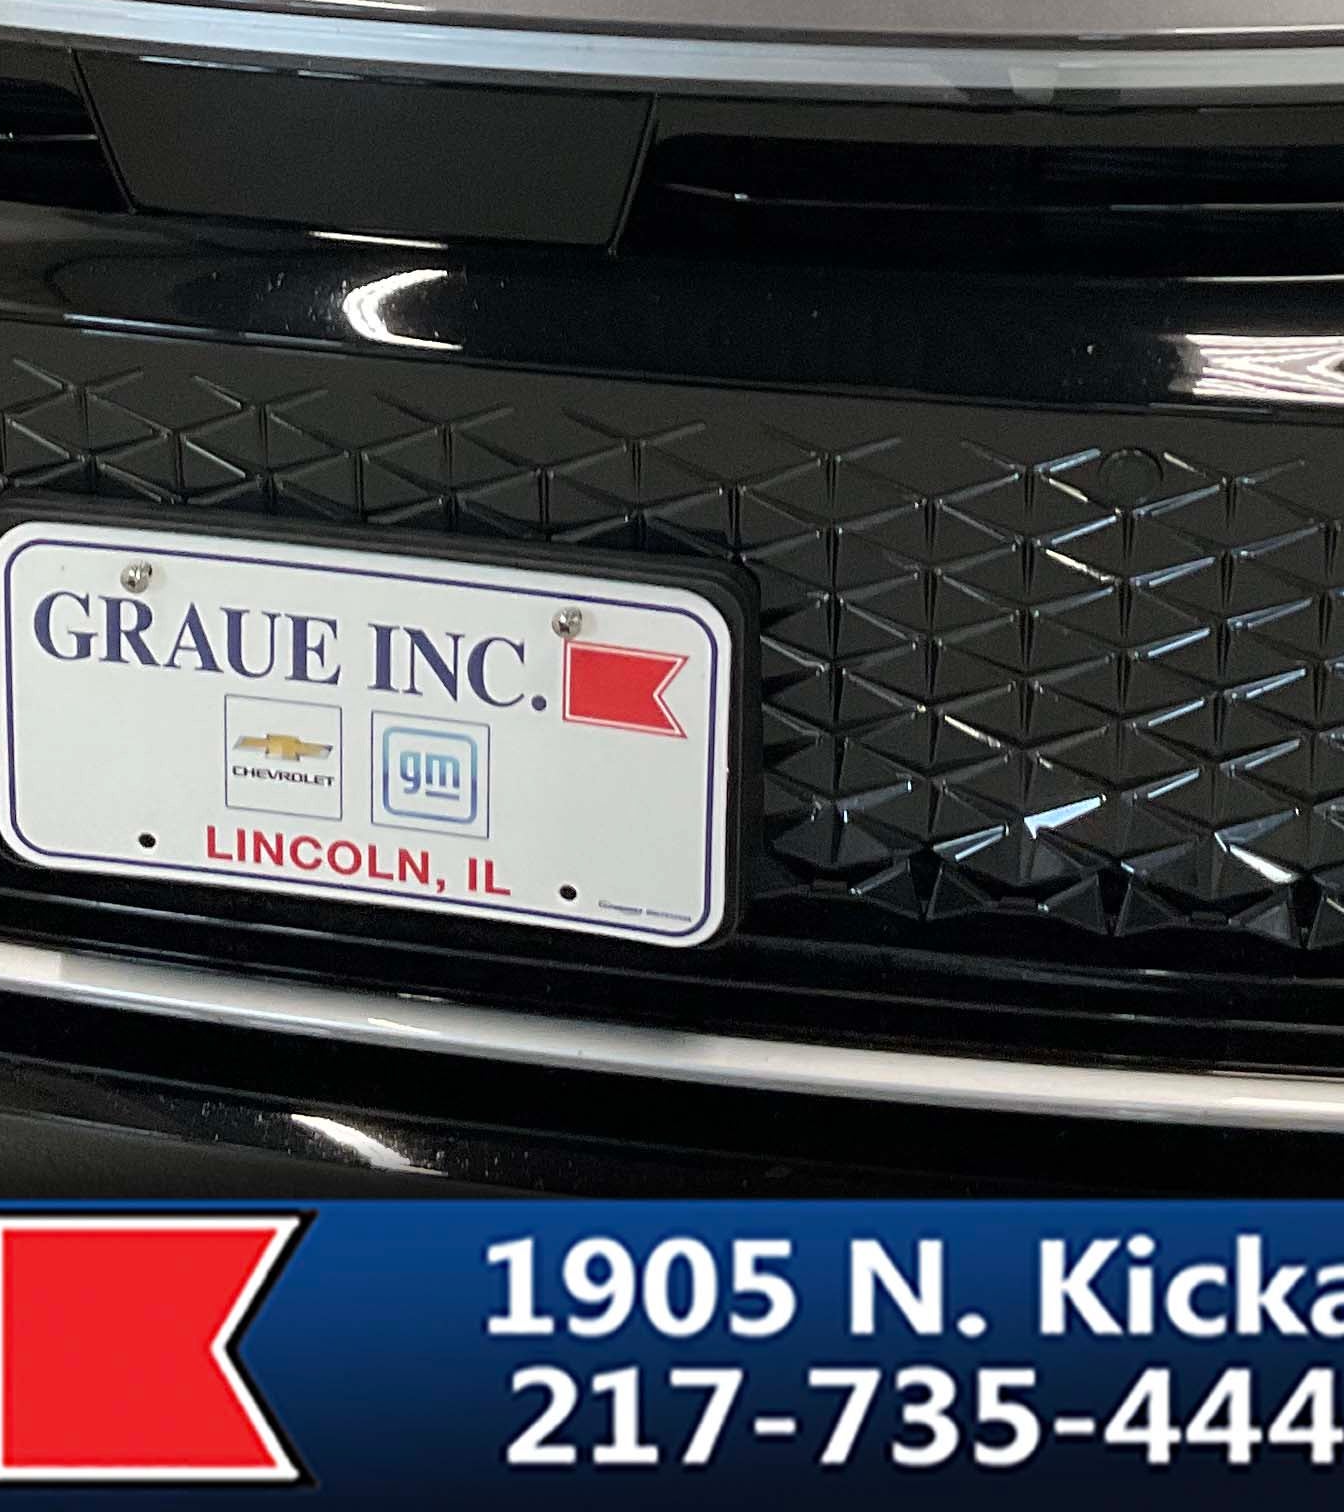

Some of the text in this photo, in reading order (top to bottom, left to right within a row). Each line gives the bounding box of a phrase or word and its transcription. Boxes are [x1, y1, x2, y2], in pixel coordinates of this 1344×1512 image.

[33, 590, 548, 713] GRAUE INC.
[232, 765, 335, 788] CHEVROLET
[399, 751, 461, 801] gm
[206, 825, 511, 896] LINCOLN, IL
